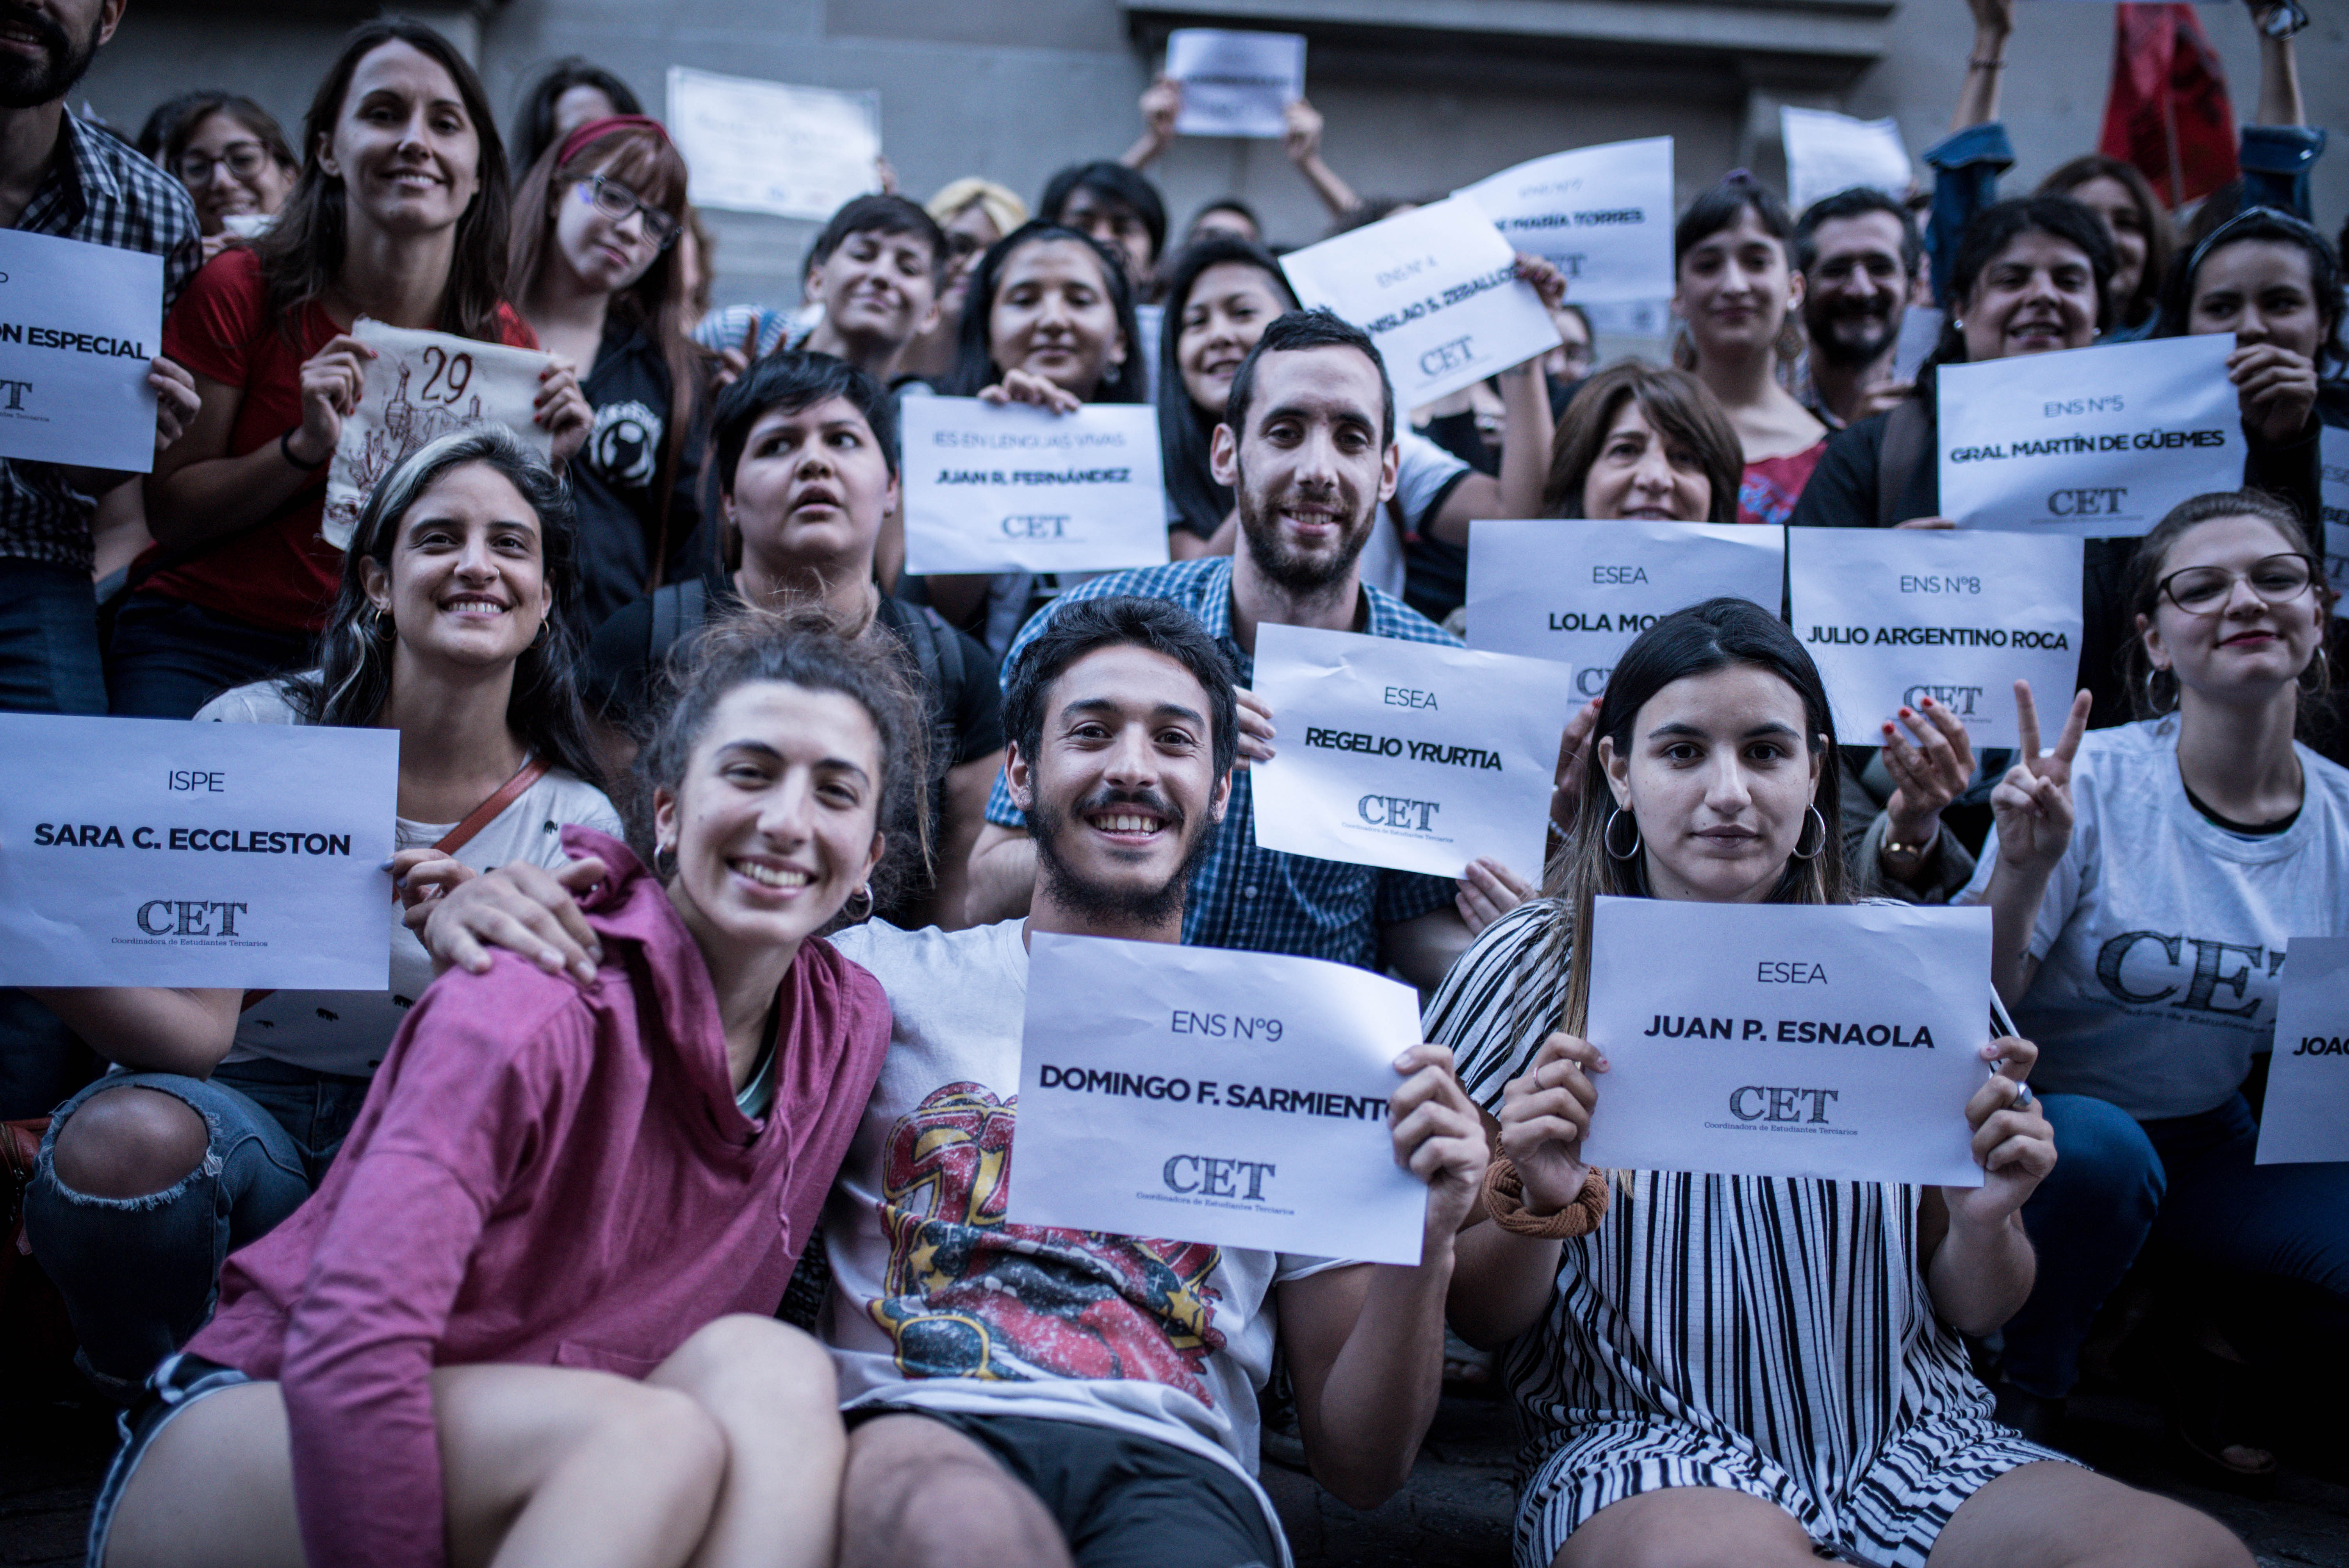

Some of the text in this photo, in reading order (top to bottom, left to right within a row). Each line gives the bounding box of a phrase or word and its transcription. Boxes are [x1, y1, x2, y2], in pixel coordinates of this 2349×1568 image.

[28, 327, 150, 361] ESPECIAL
[422, 346, 473, 404] 29
[2044, 399, 2085, 418] ENS
[2012, 432, 2095, 458] MARTÍN
[2100, 434, 2129, 451] DE
[2133, 428, 2226, 450] GÜEMES
[936, 470, 987, 485] JUAN
[2048, 487, 2127, 517] CET
[1001, 515, 1071, 538] CET
[1593, 566, 1648, 584] ESEA
[1901, 575, 1941, 593] ENS
[1549, 613, 1667, 632] LOLA MO
[1807, 627, 2069, 650] JULIO ARGENTINO ROCA
[1385, 686, 1438, 711] ESEA
[1305, 727, 1503, 772] REGELIO YRURTIA
[169, 770, 225, 792] ISPE
[1358, 794, 1440, 832] CET
[34, 823, 351, 855] SARA C. ECCLESTON
[137, 900, 248, 937] CET
[111, 937, 166, 945] Coordinadora
[1757, 962, 1828, 984] ESEA
[2096, 930, 2286, 1018] CE
[1172, 1010, 1226, 1037] ENS
[1644, 1015, 1935, 1049] JUAN P. ESNAOLA
[1040, 1064, 1390, 1122] DOMINGO F. SARMIENT
[1729, 1085, 1838, 1124] CET
[1704, 1122, 1757, 1131] Coordinadora
[1770, 1125, 1817, 1134] Estudiantes
[1819, 1127, 1858, 1136] Terciarios
[1163, 1154, 1276, 1201] CET
[1136, 1192, 1191, 1205] Coordinadora
[1205, 1199, 1252, 1210] Estudiantes
